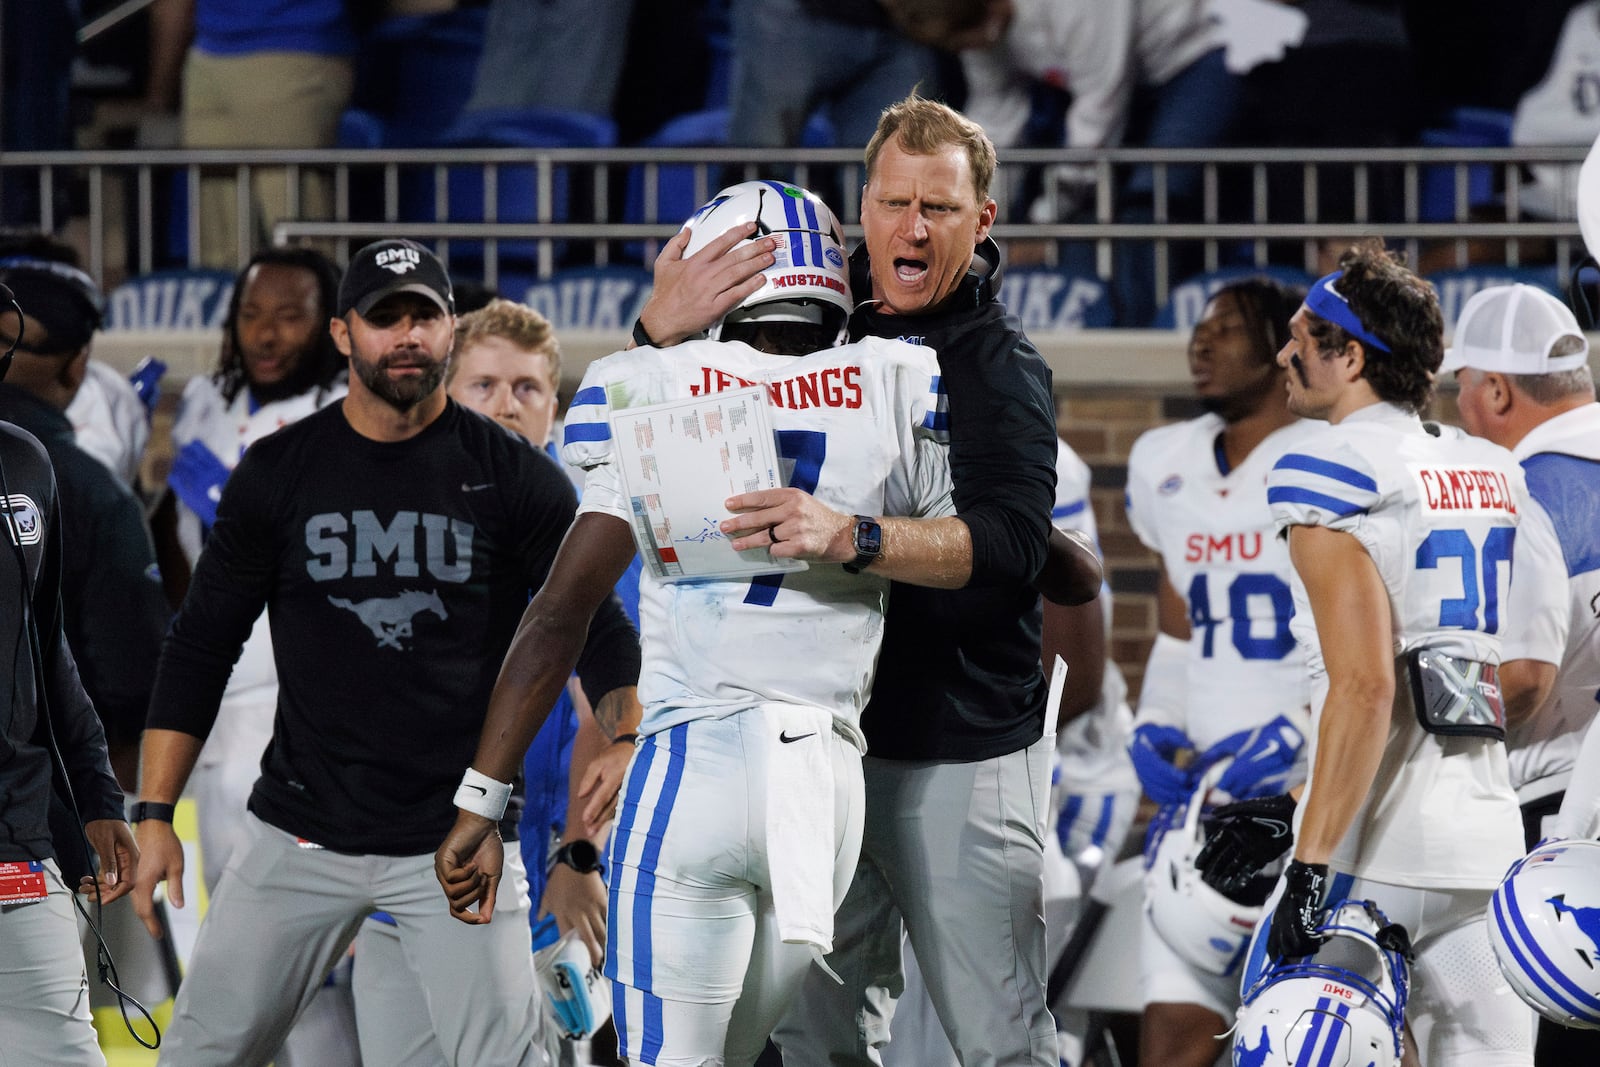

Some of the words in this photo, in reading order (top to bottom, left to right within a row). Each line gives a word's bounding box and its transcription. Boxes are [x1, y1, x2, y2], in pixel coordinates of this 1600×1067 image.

[375, 248, 420, 266] SMU
[771, 273, 846, 296] MUSTANGS
[689, 366, 864, 410] JENINGS
[1420, 469, 1517, 515] CAMPBELL
[743, 430, 826, 607] 7
[305, 510, 474, 584] SMU
[1185, 531, 1263, 563] SMU
[1416, 527, 1517, 635] 30
[1188, 572, 1297, 661] 40
[1323, 983, 1353, 1000] SMU
